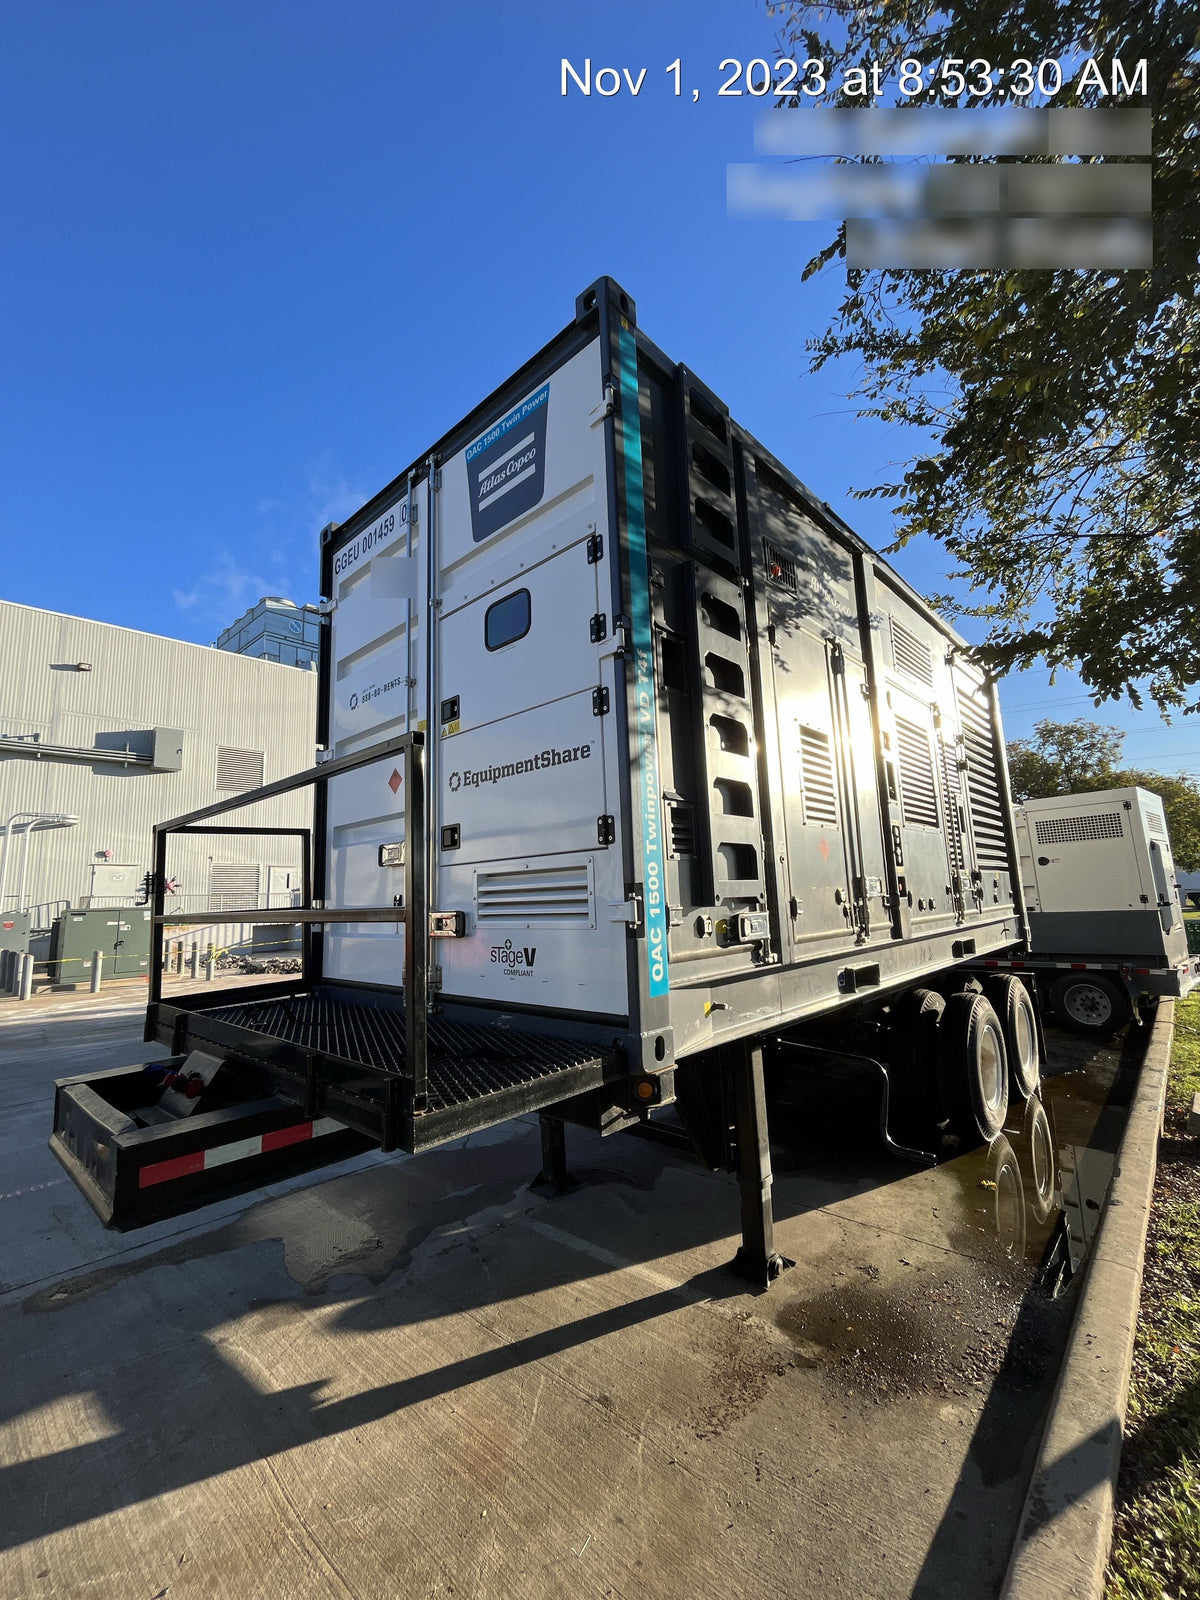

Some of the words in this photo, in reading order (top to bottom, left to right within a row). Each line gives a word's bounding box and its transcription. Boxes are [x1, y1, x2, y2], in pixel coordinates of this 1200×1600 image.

[466, 442, 483, 460] QAC
[483, 428, 501, 446] 1500
[501, 412, 521, 431] Twin
[522, 390, 549, 416] Power
[478, 470, 506, 498] Atlas
[506, 448, 537, 477] Copco
[334, 541, 361, 575] GGEU
[362, 514, 395, 554] 001459
[401, 503, 408, 523] 0
[636, 647, 649, 684] T4f
[639, 690, 651, 723] VD
[463, 744, 591, 788] EquipmentShare
[643, 729, 659, 855] Twinpower
[647, 861, 660, 918] 1500
[503, 968, 534, 977] COMPLIANT
[649, 927, 665, 982] QAC
